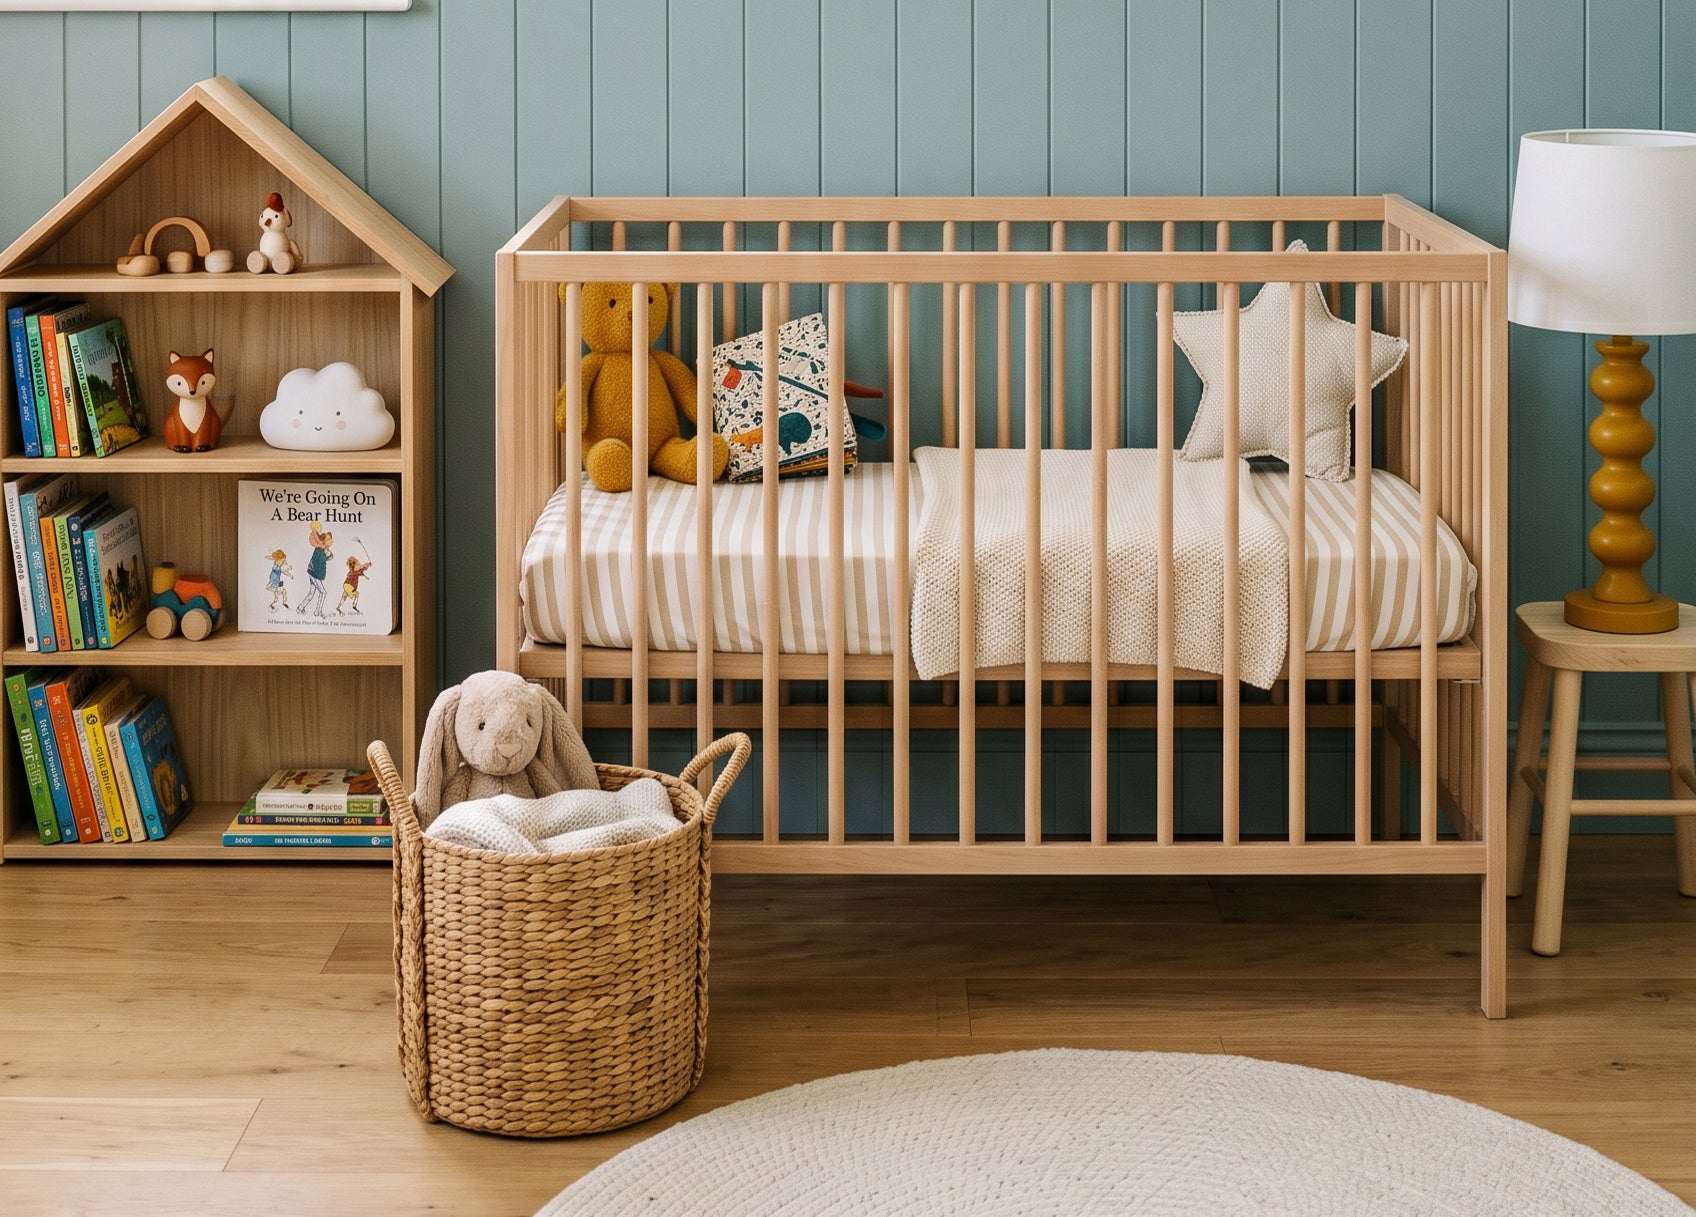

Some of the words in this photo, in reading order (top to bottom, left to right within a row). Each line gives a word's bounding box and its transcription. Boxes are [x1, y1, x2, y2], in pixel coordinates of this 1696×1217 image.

[259, 488, 301, 504] We're
[305, 490, 350, 508] Going
[353, 491, 376, 506] On
[271, 507, 282, 521] A
[288, 508, 321, 522] Bear
[325, 509, 363, 523] Hunt
